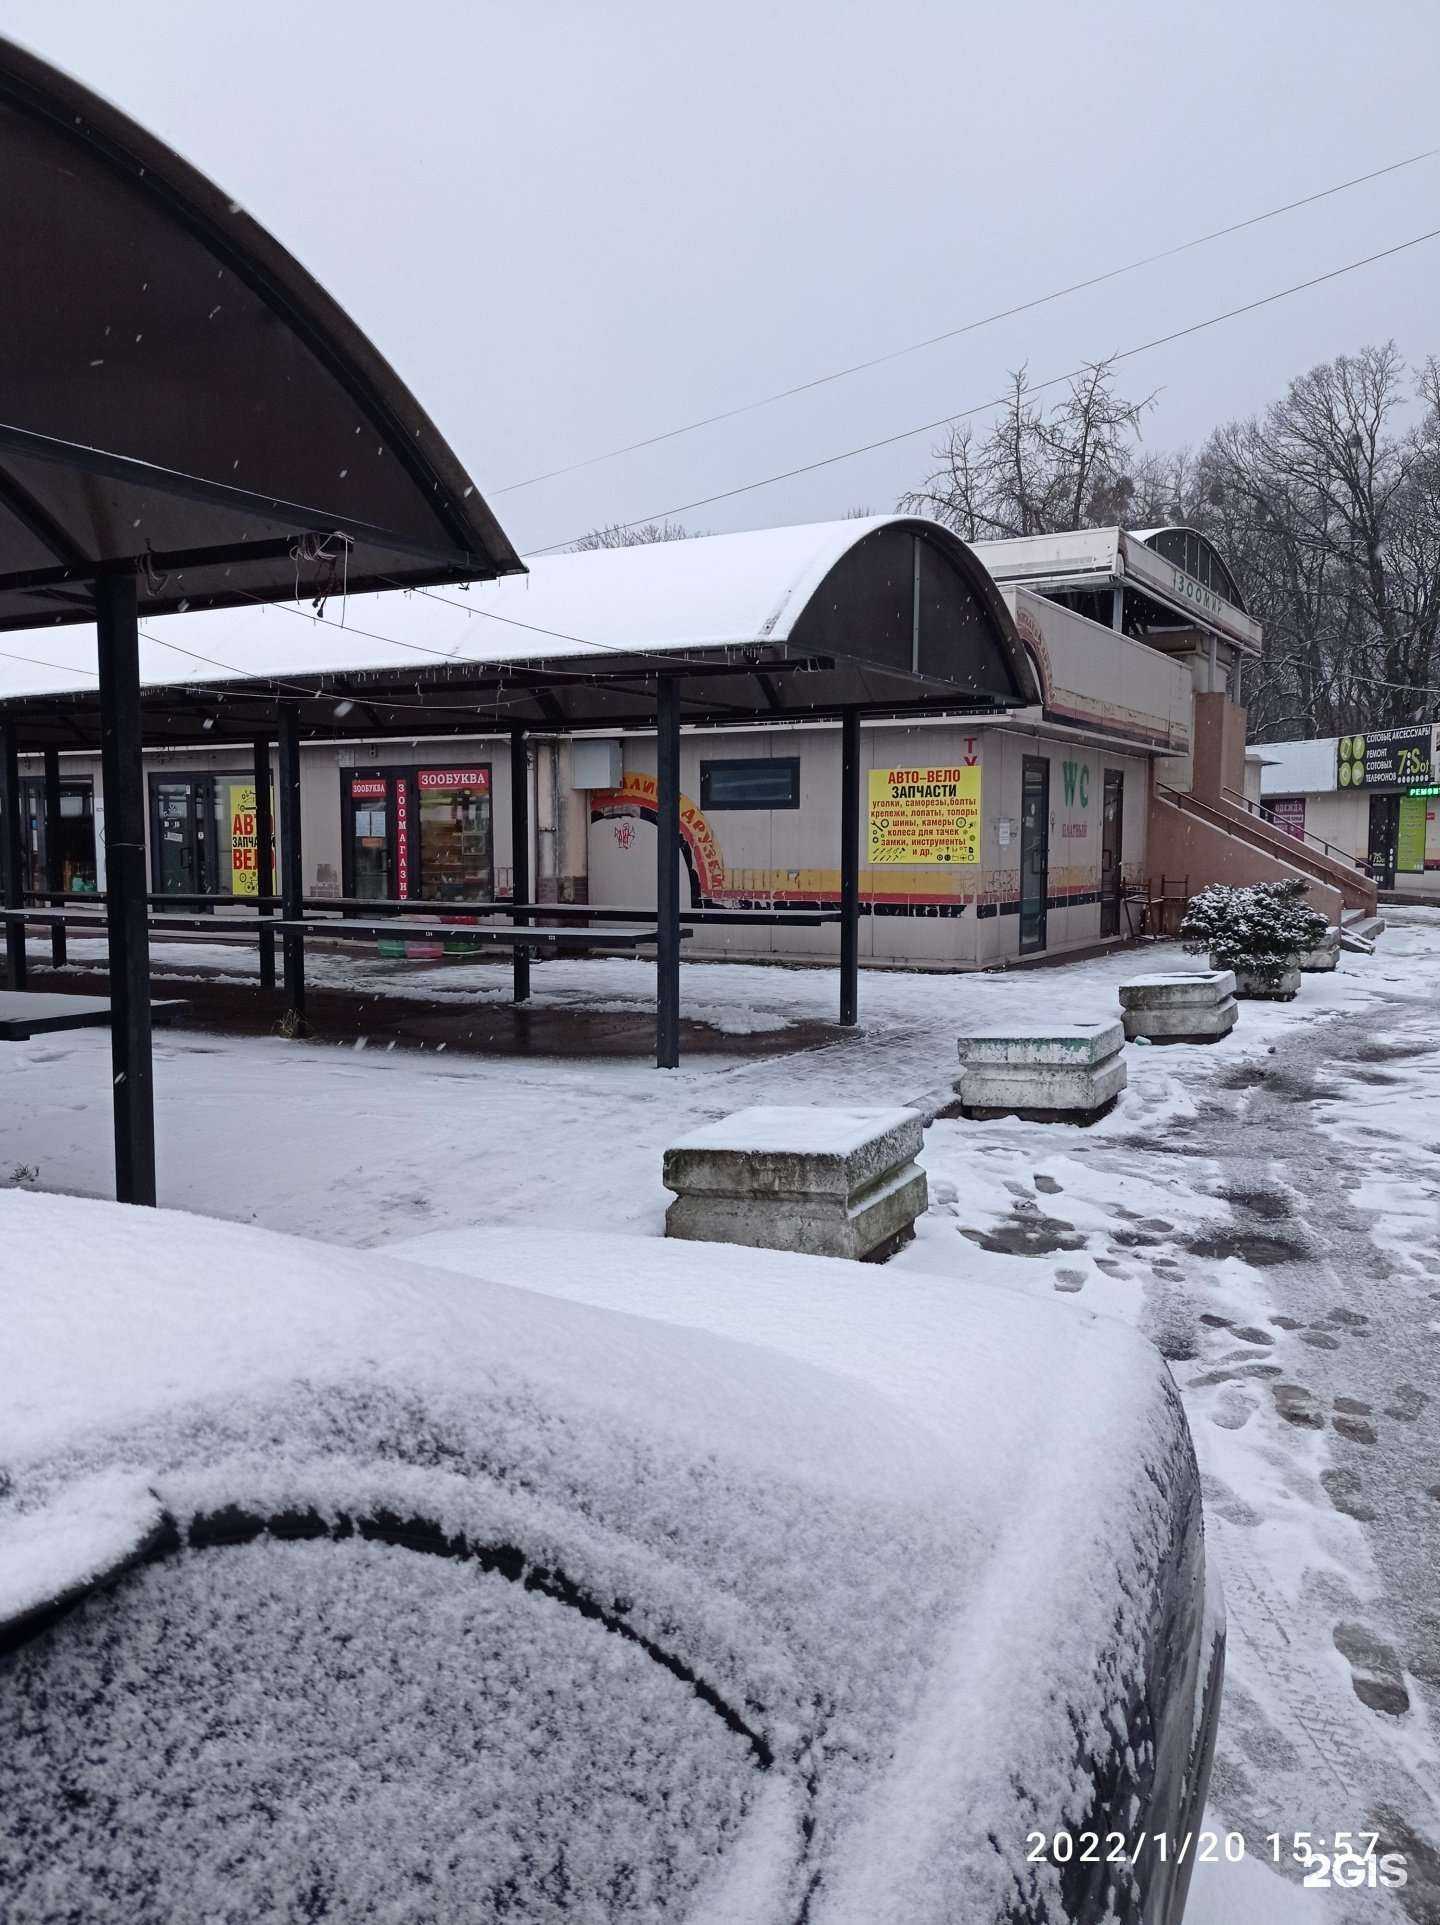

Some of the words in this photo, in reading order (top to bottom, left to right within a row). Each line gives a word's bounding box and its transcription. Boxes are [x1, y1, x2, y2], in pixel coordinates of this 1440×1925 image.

[1366, 732, 1391, 743] СОТОВЫЕ
[1392, 727, 1431, 740] АКСЕССУАРЫ
[1366, 748, 1388, 759] РЕМОНТ
[1366, 760, 1392, 770] СОТОВЫХ
[421, 773, 485, 785] ЗООБУКВА
[888, 769, 961, 784] АВТО-ВЕЛО
[1365, 772, 1397, 782] ТЕЛЕФОНОВ
[352, 784, 385, 793] ЗООБУКВА
[1062, 760, 1089, 808] WC
[891, 784, 957, 798] ЗАПЧАСТИ
[947, 808, 978, 818] топоры
[922, 818, 954, 828] камеры
[887, 828, 916, 836] колеса
[918, 828, 933, 837] для
[936, 827, 959, 836] тачек
[912, 838, 966, 847] инструменты
[920, 848, 933, 857] др.
